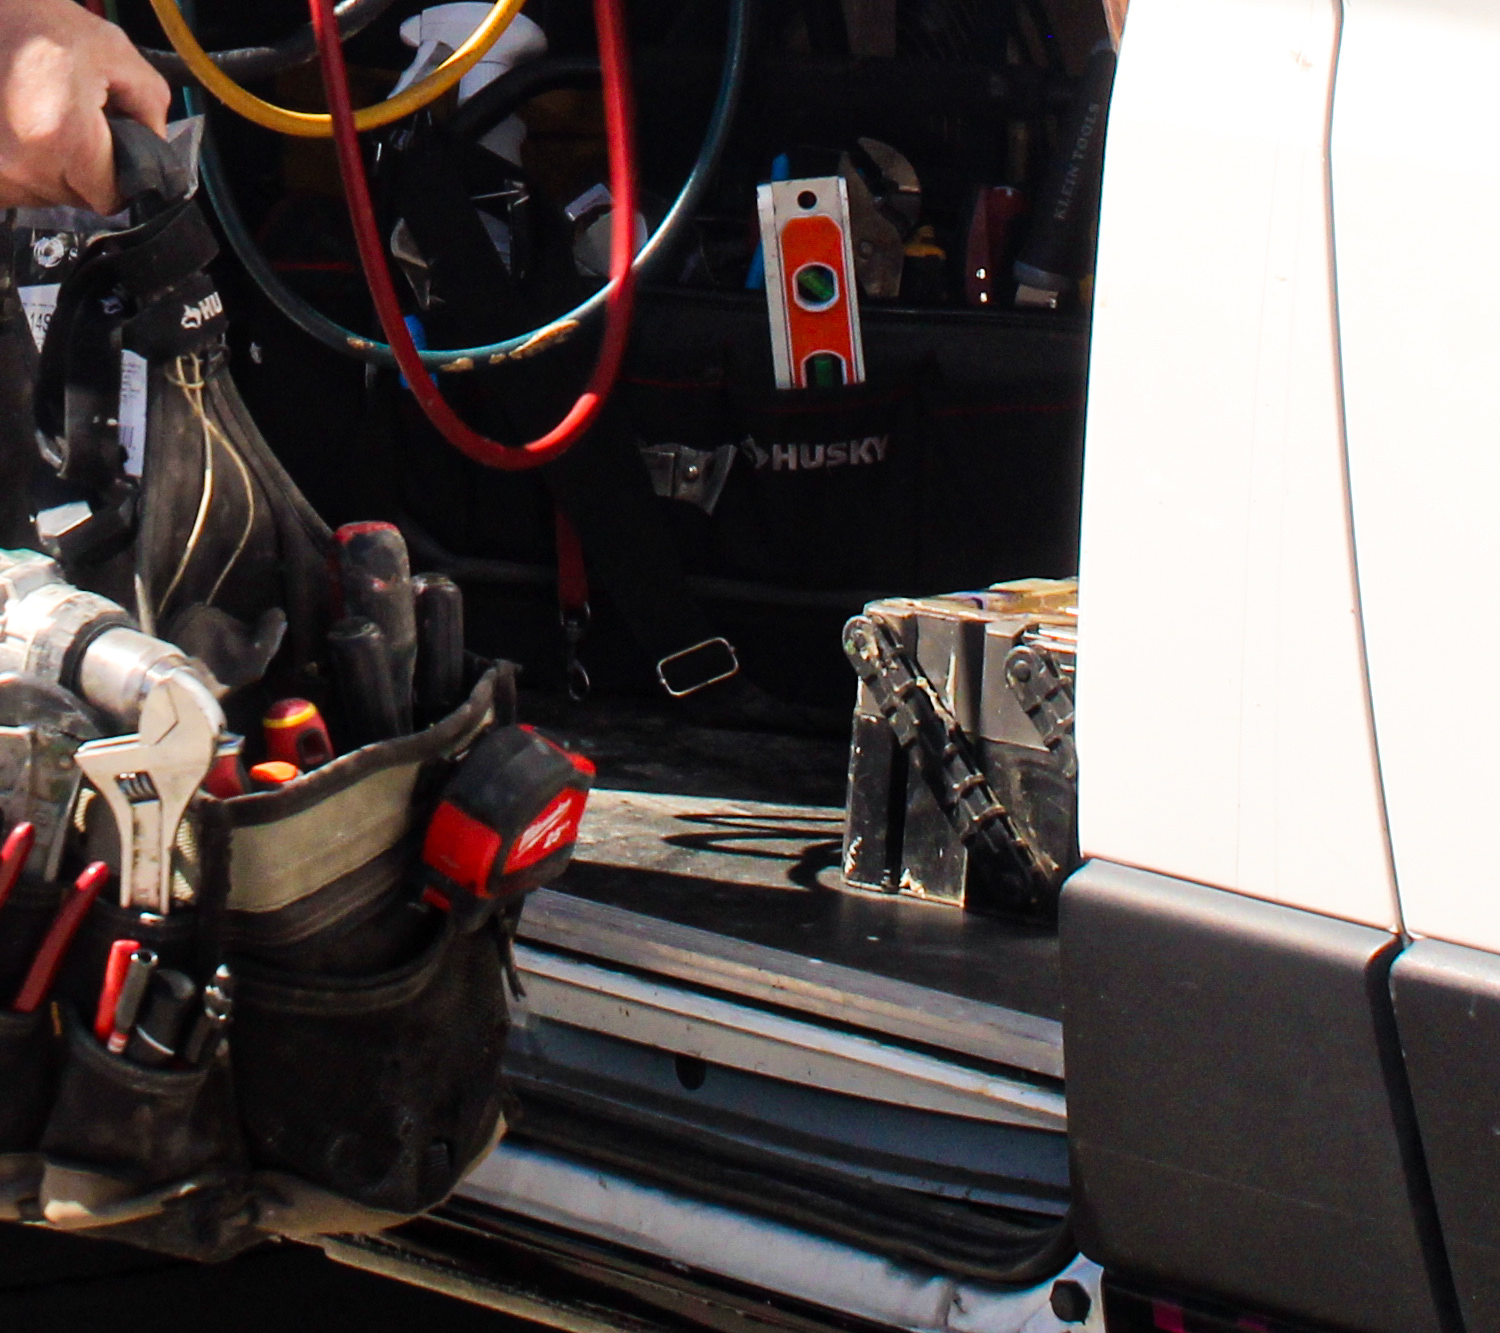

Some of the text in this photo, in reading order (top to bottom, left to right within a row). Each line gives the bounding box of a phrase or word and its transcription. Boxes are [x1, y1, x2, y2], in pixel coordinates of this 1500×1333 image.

[1053, 103, 1100, 222] KLEIN TOOLS
[772, 434, 889, 472] HUSKY
